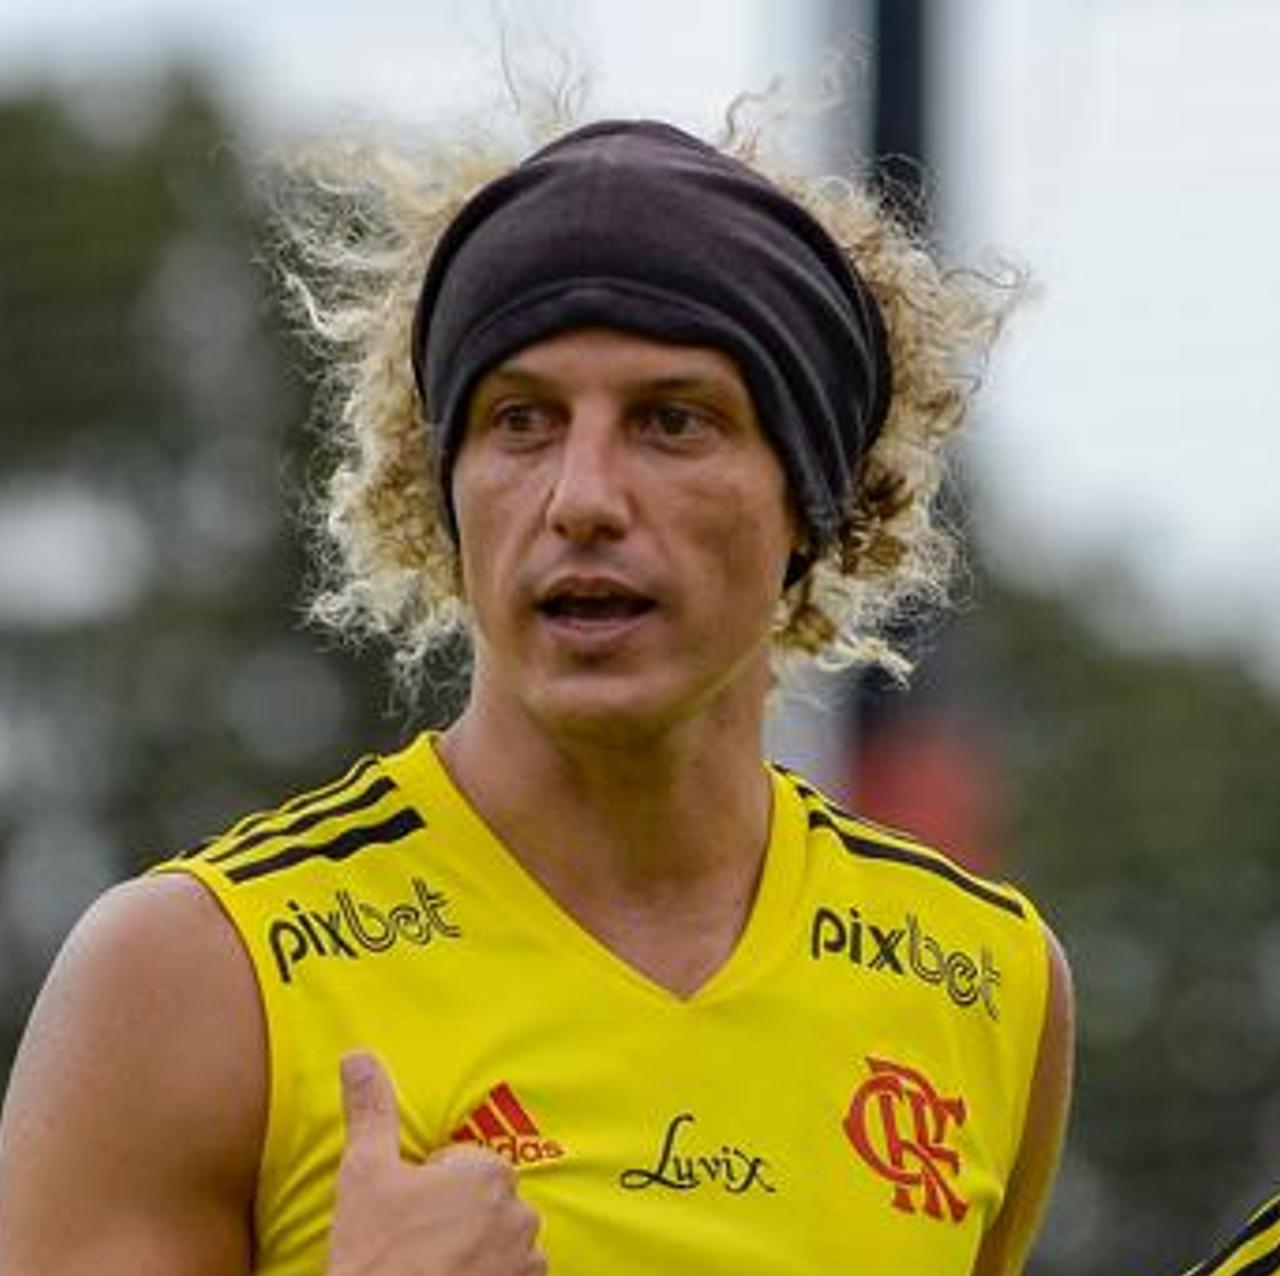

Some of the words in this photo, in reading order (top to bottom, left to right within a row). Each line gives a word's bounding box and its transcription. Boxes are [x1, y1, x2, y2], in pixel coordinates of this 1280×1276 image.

[270, 877, 461, 984] pixbet
[811, 906, 1001, 1021] pixbet
[620, 1113, 776, 1194] Luvix
